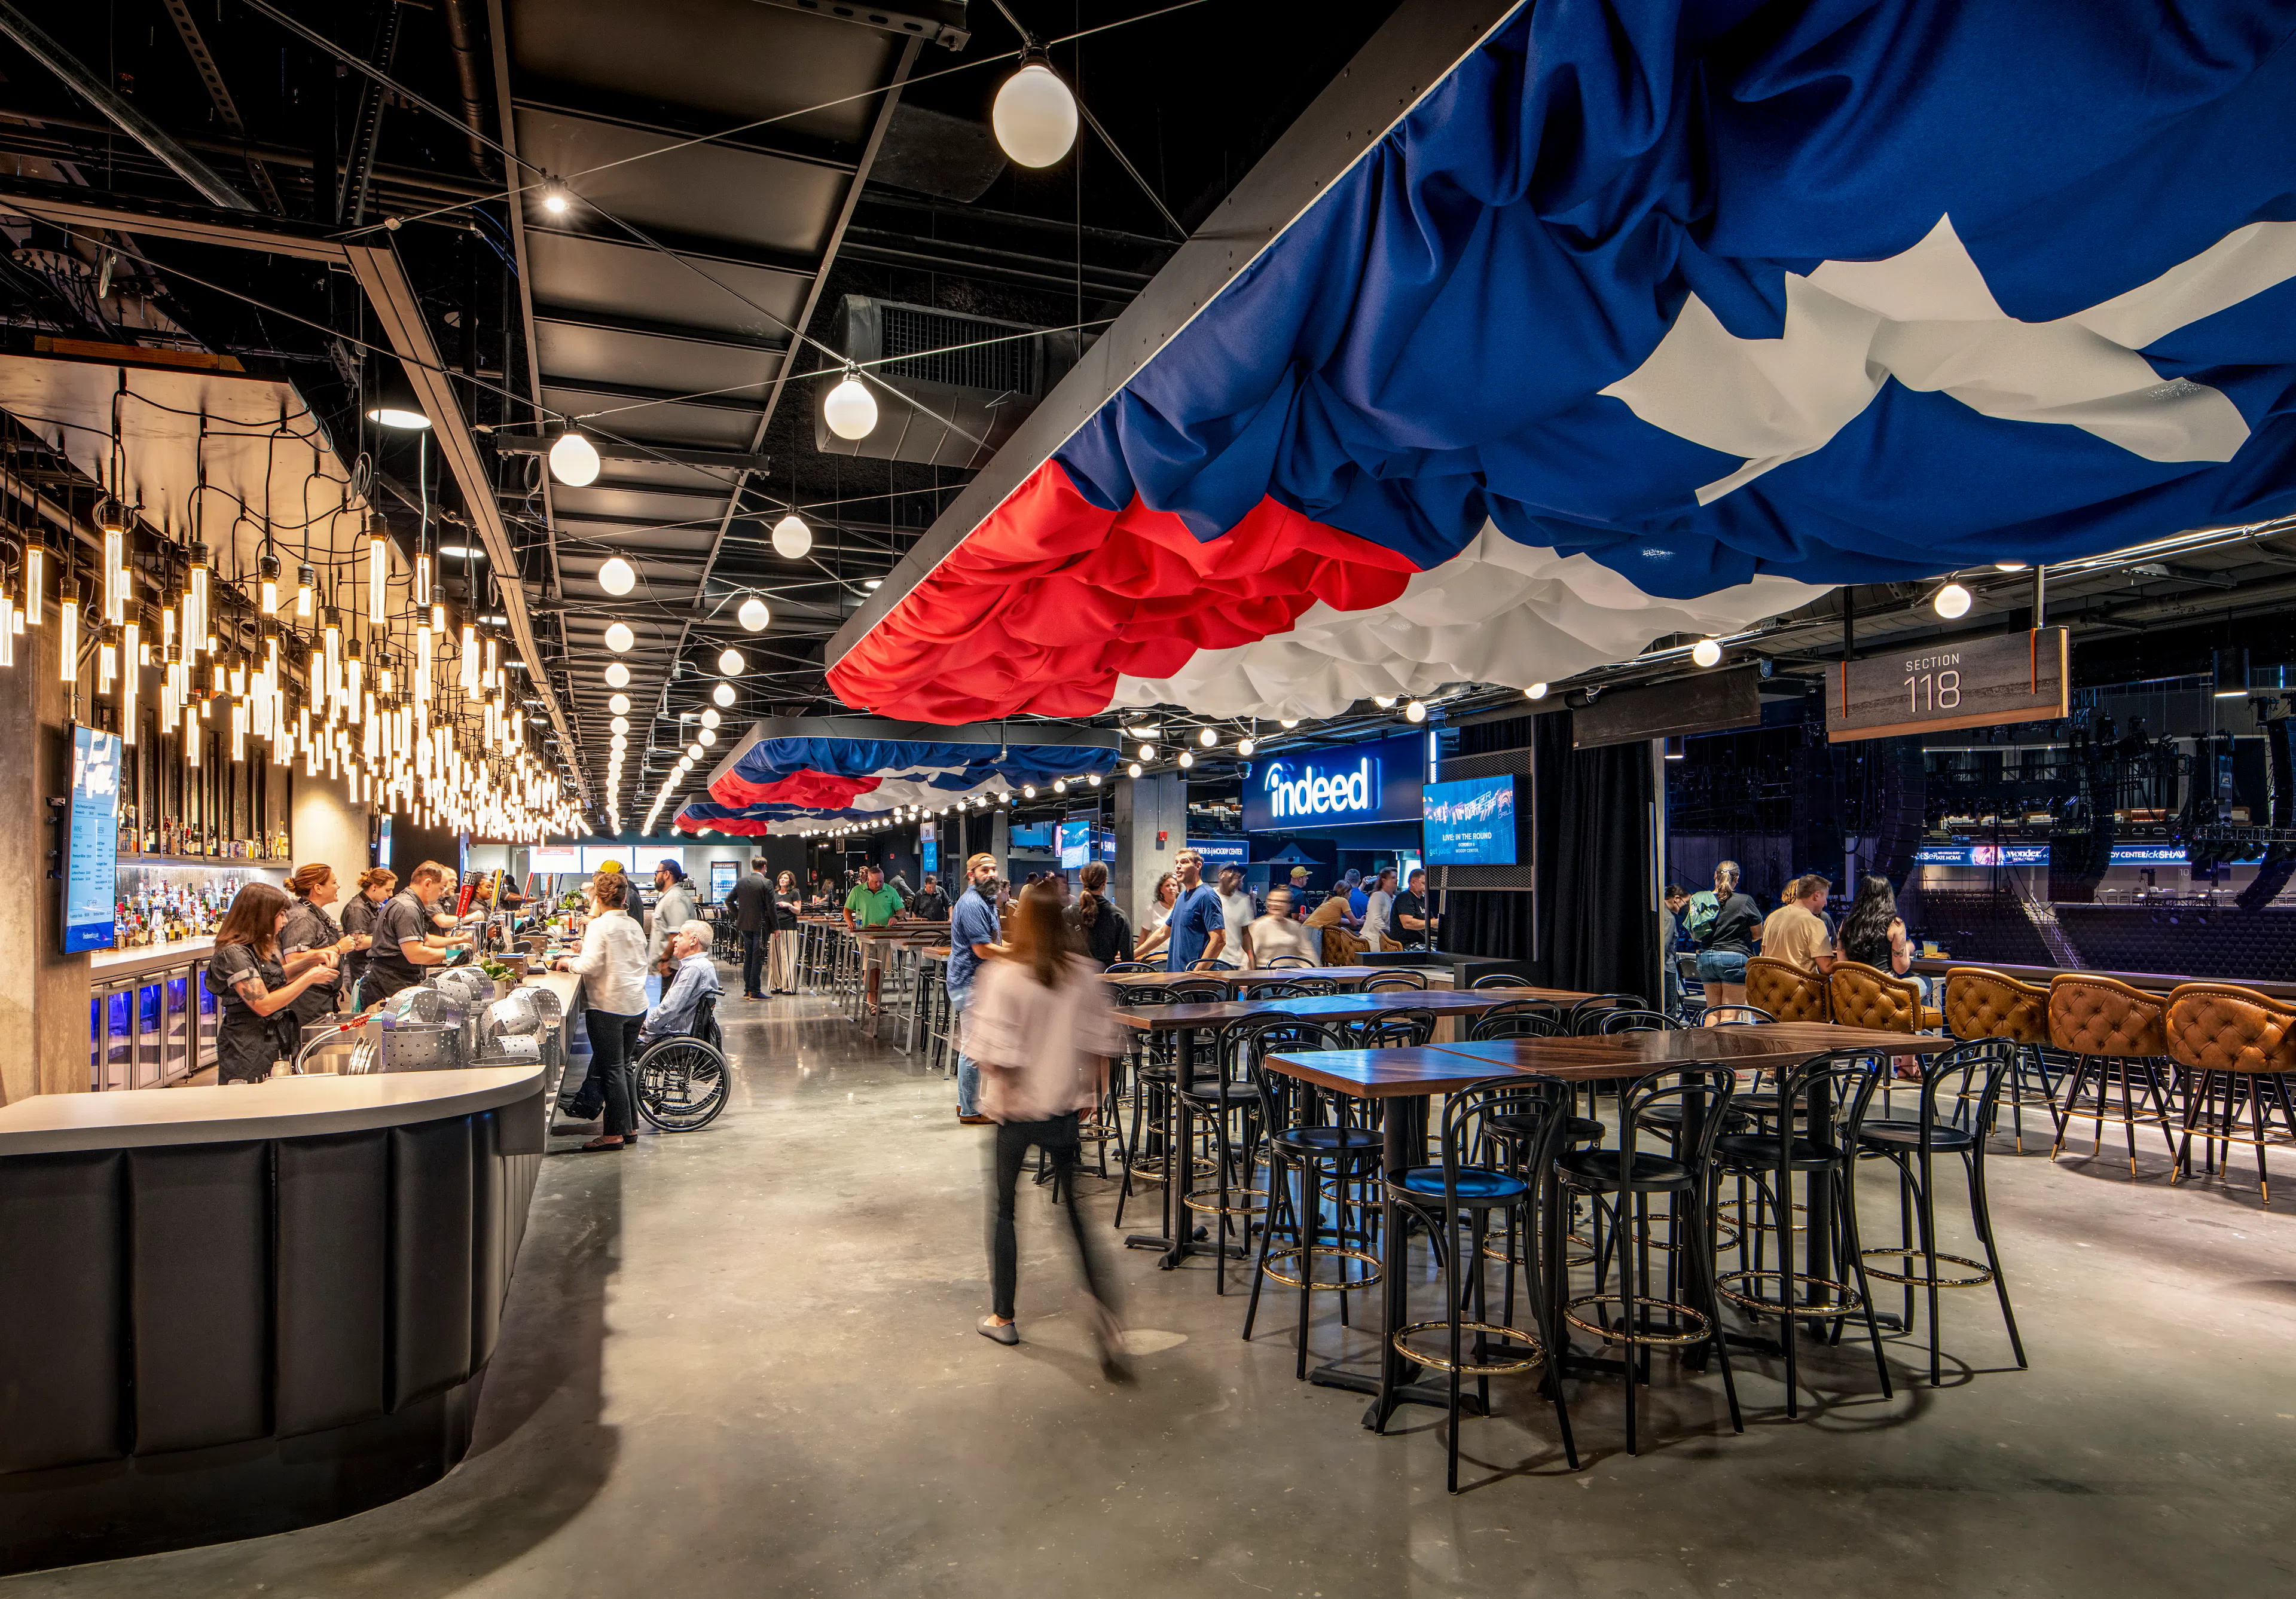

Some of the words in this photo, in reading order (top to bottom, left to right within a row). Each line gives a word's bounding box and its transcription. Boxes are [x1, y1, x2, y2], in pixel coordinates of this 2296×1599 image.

[1906, 653, 1959, 672] SECTION
[1904, 670, 1961, 713] 118
[1265, 757, 1368, 817] indeed
[1498, 809, 1513, 820] DRILL
[1429, 848, 1438, 857] get
[1438, 847, 1451, 856] jobs.
[2179, 868, 2190, 876] 10
